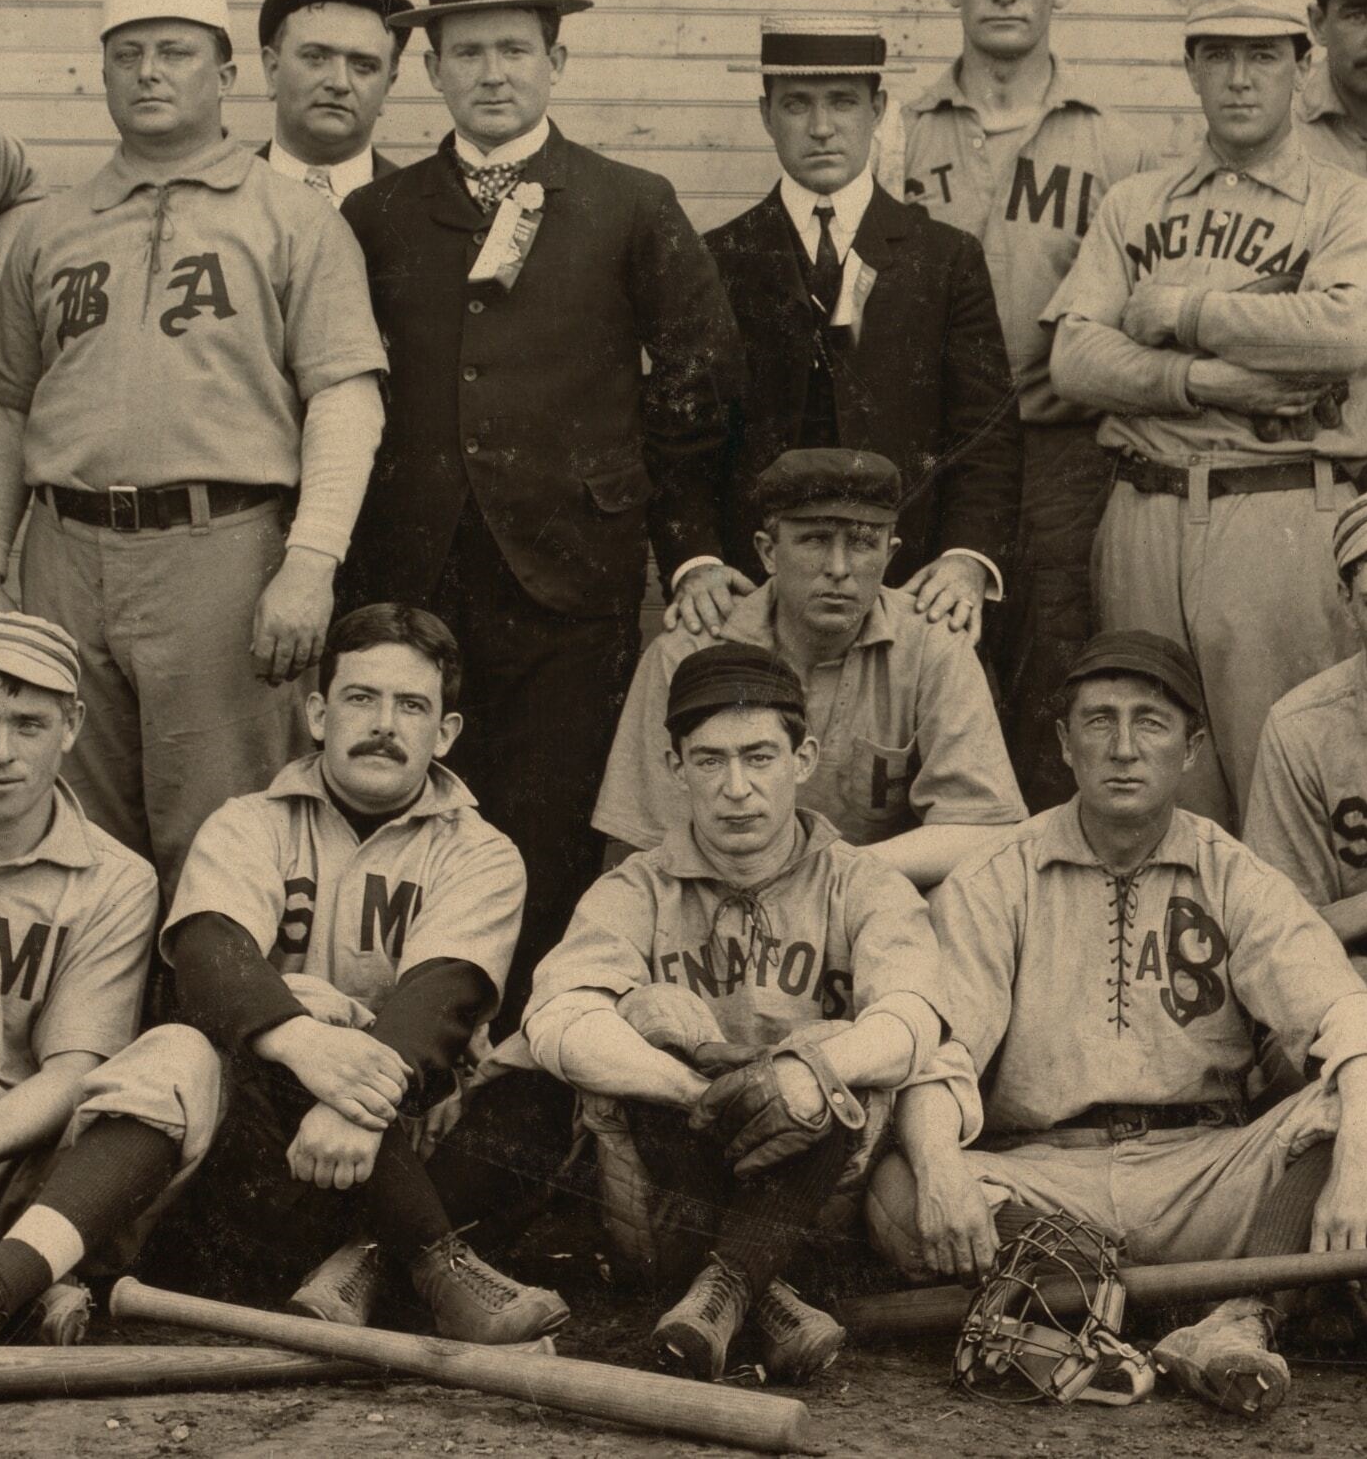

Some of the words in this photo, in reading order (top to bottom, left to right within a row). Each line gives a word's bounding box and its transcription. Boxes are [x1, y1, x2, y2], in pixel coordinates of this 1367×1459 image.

[51, 260, 111, 351] B
[159, 252, 238, 338] A
[659, 936, 855, 1021] ENATOS
